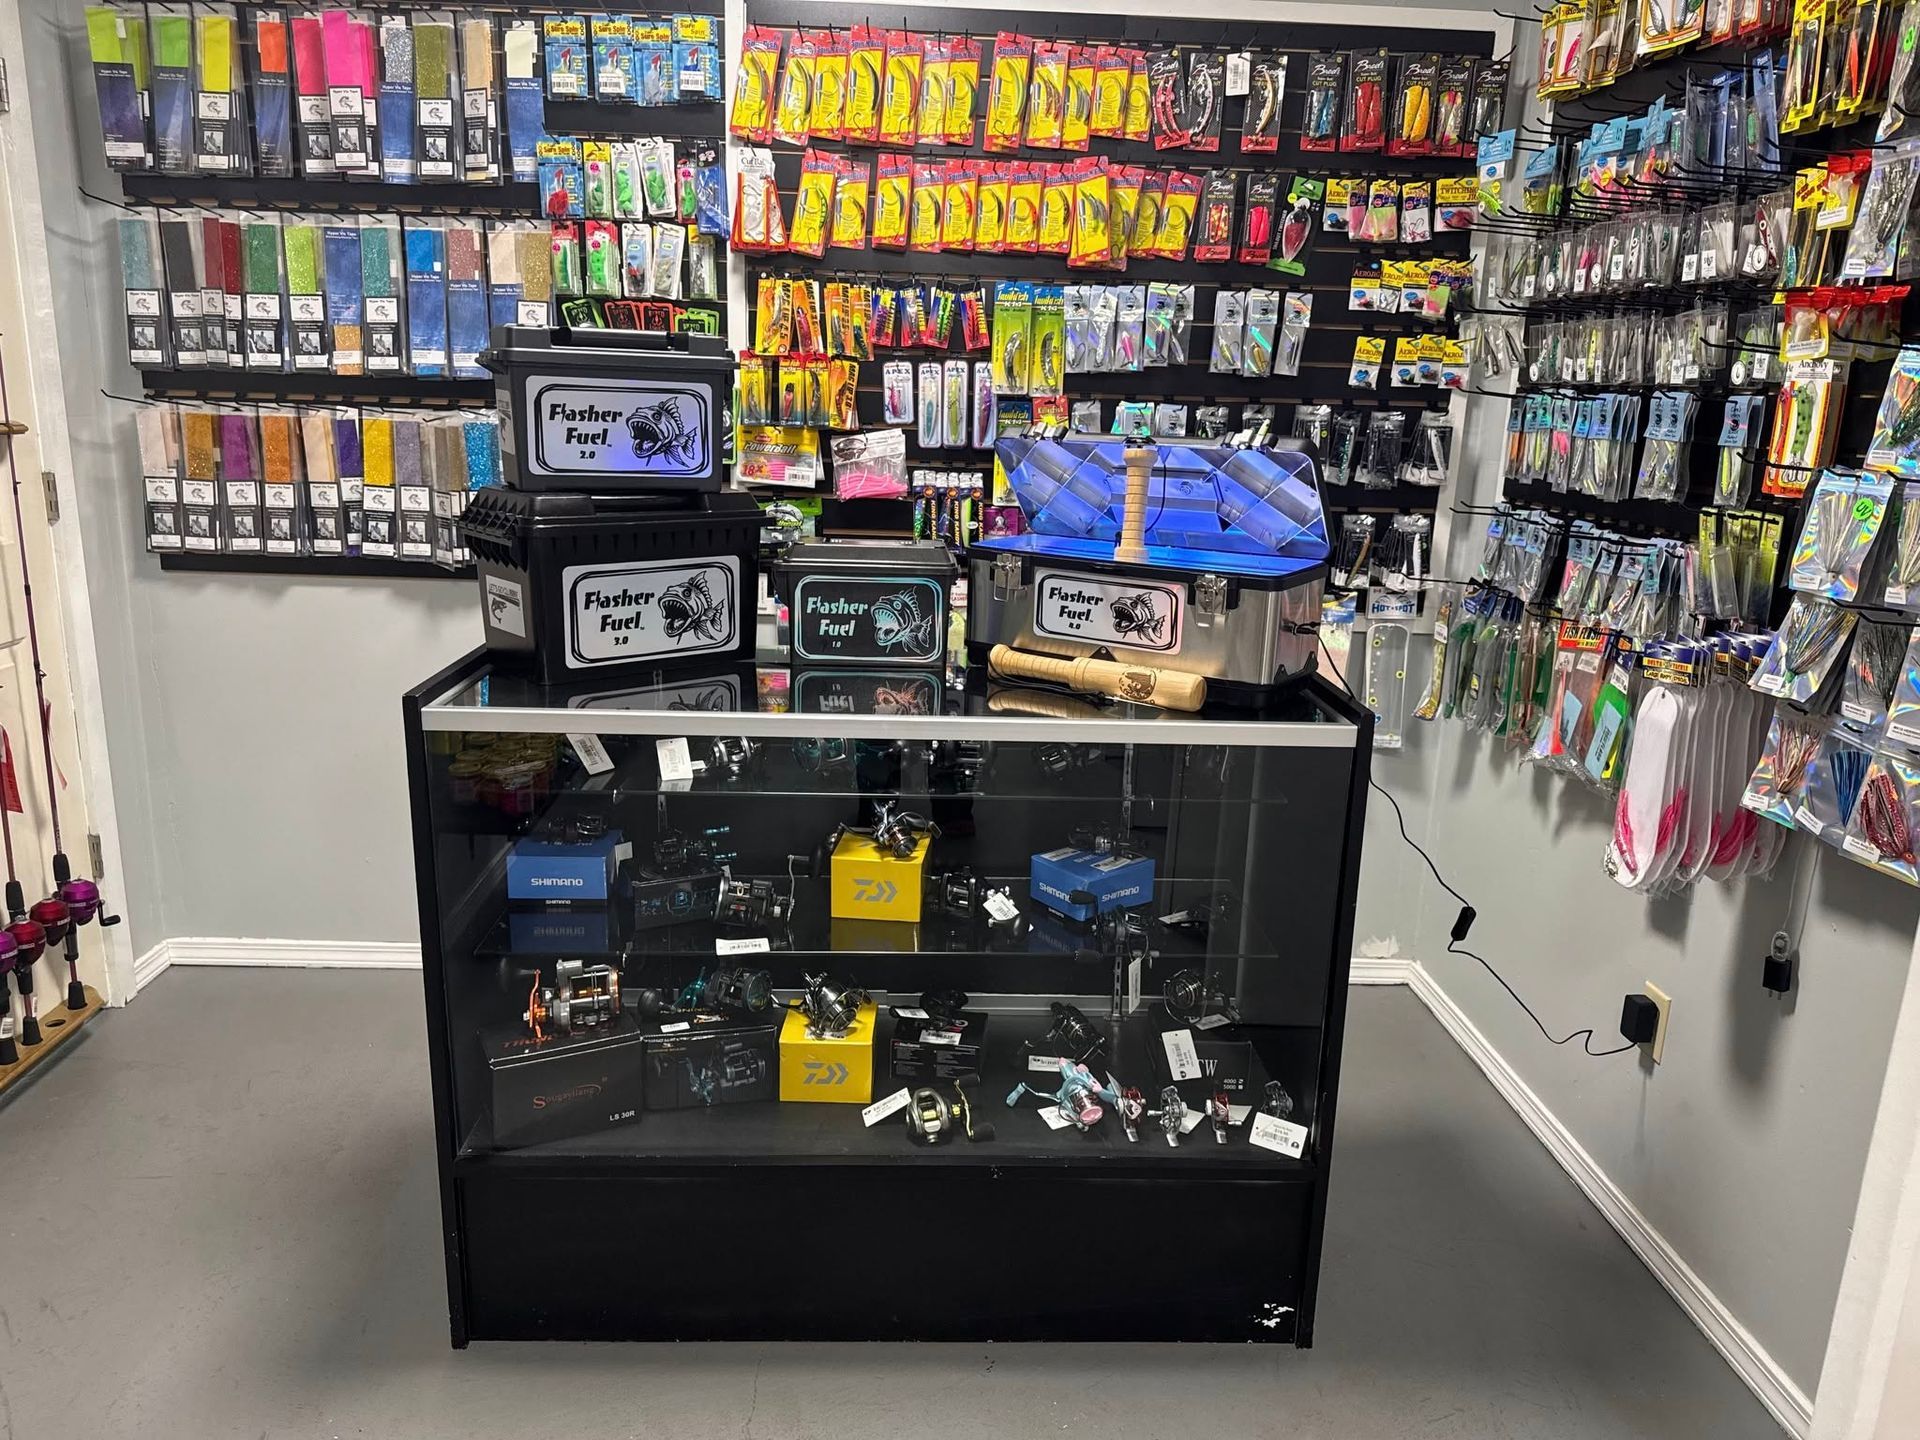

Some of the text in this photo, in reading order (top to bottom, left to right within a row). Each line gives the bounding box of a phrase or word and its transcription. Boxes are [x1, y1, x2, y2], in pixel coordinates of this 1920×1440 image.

[548, 402, 622, 424] Flasher
[565, 428, 608, 445] Fuel
[580, 450, 596, 459] 2.0
[744, 442, 798, 454] PowerBait
[1856, 501, 1869, 516] UV
[584, 589, 654, 612] Flasher
[1049, 586, 1103, 607] Flasher
[806, 596, 869, 615] Flasher
[1372, 603, 1390, 614] HOT
[1059, 606, 1091, 622] Fuel
[600, 612, 641, 633] Fuel
[819, 620, 855, 636] Fuel
[614, 636, 628, 645] 3.0
[531, 878, 583, 886] SHIMANO
[1101, 886, 1140, 902] SHIMANO
[610, 1110, 635, 1121] LS 30R
